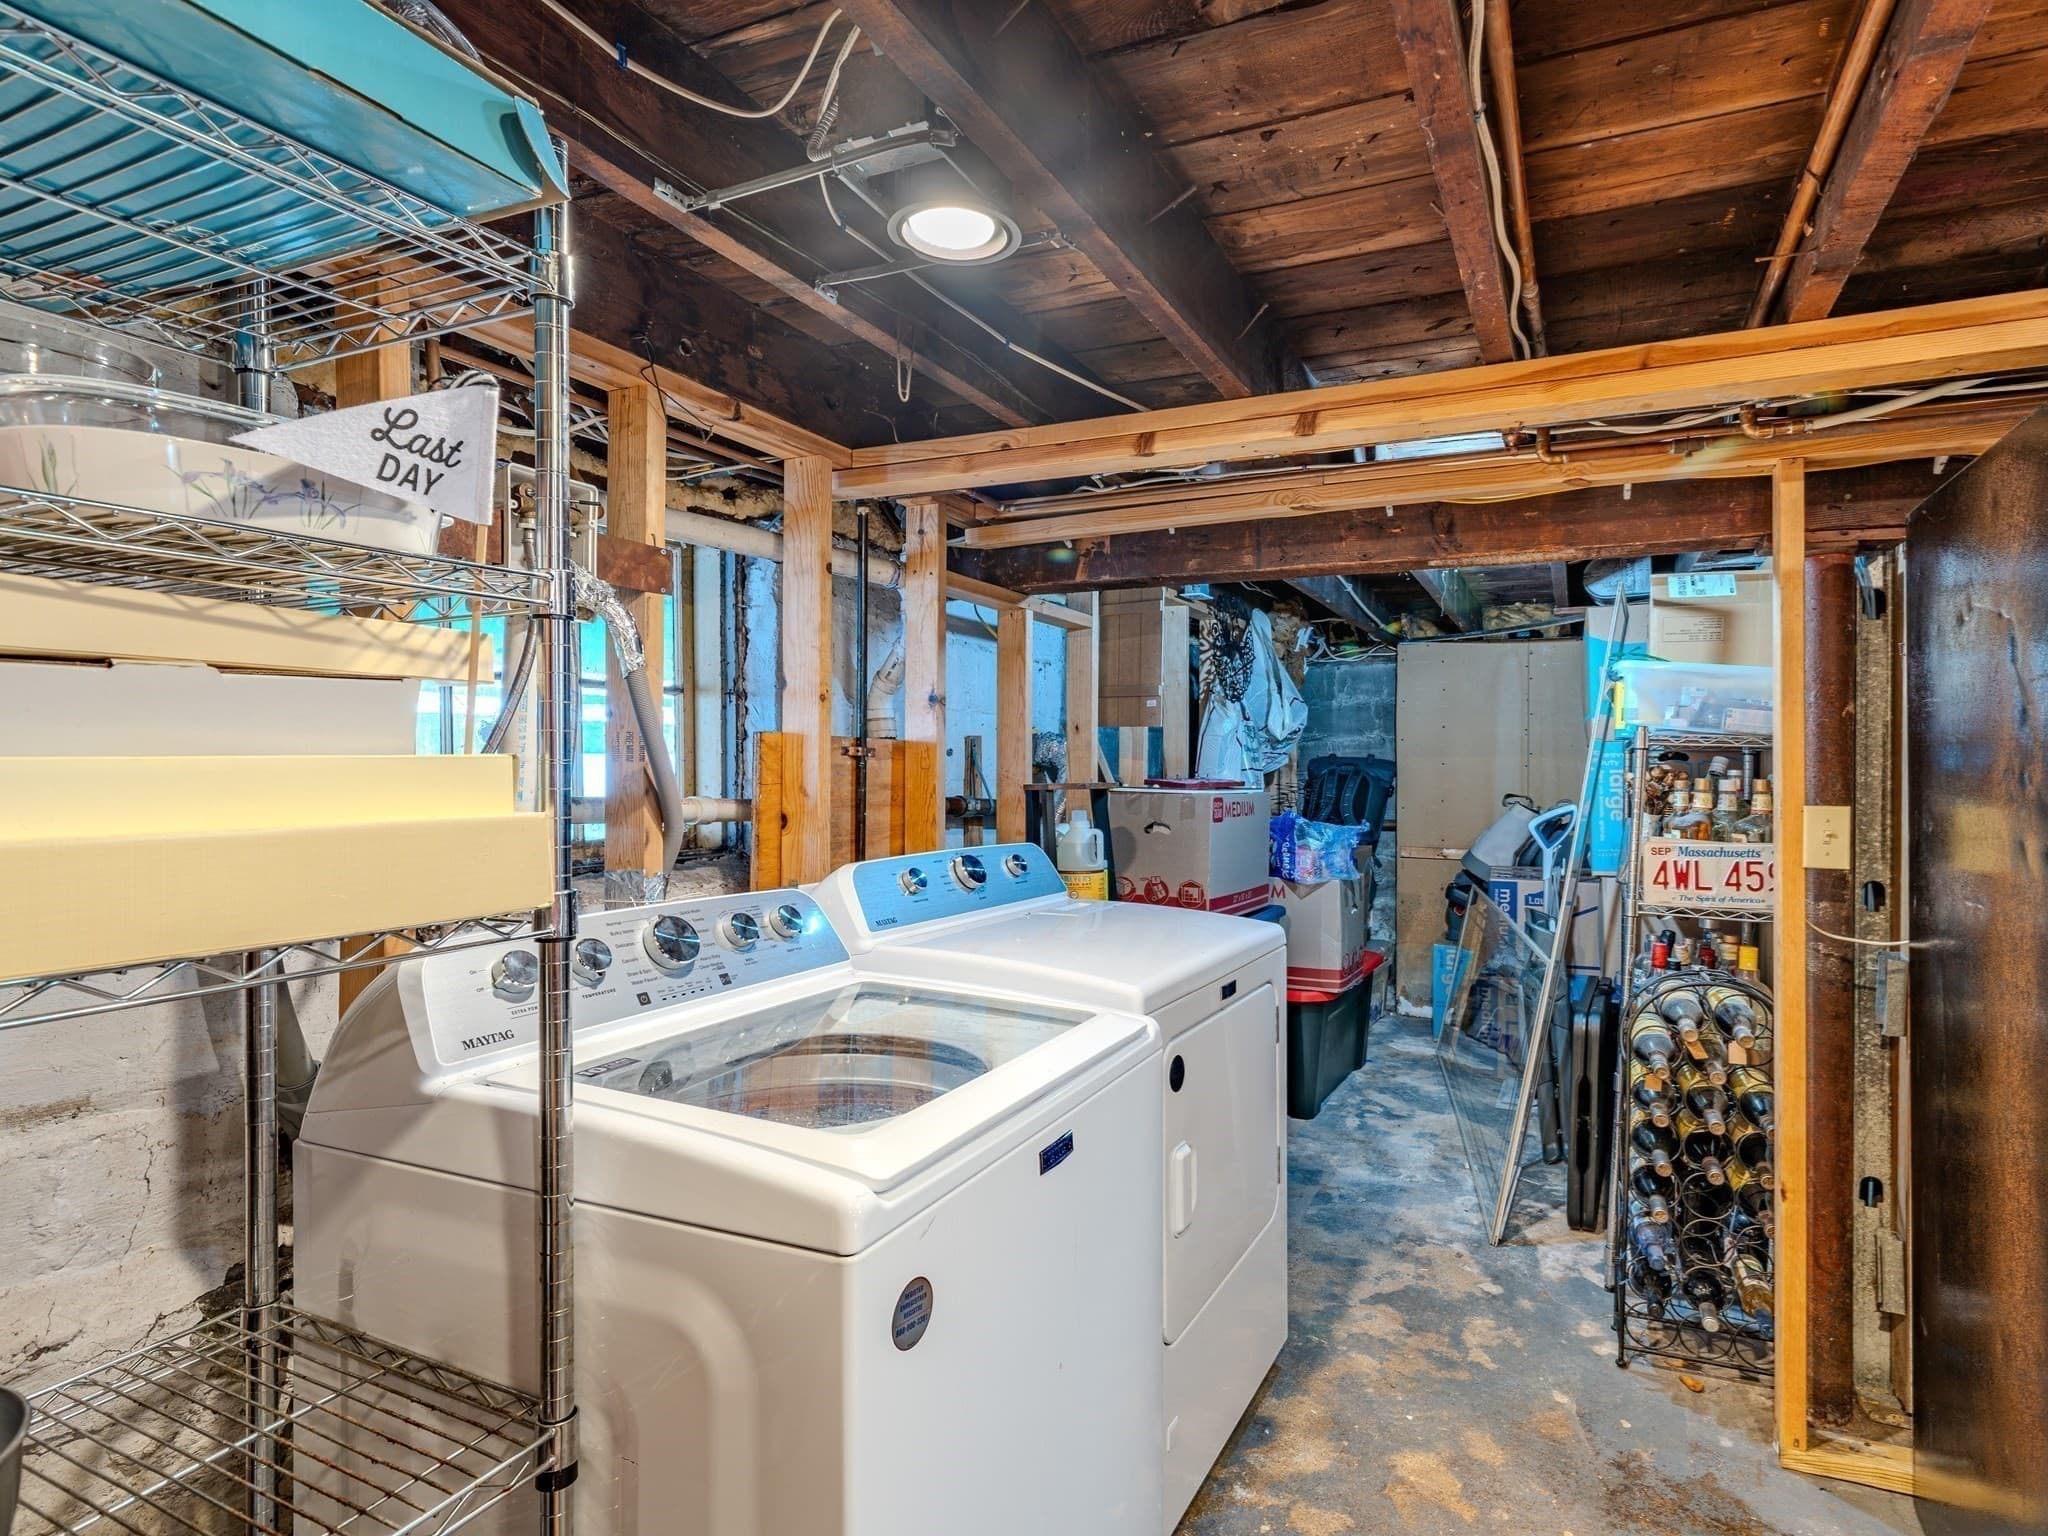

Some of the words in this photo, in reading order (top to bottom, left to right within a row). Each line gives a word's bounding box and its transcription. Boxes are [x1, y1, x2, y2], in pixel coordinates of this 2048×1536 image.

[371, 406, 464, 468] Last
[376, 452, 445, 496] DAY
[1605, 767, 1625, 822] large
[1224, 800, 1256, 818] MEDIUM
[1650, 846, 1672, 856] SEP
[1677, 846, 1761, 858] Massachusetts
[1652, 859, 1713, 891] 4WL
[1680, 894, 1694, 902] The
[1695, 895, 1717, 903] Spirit
[1727, 896, 1761, 904] America
[581, 987, 617, 1000] TEMPERATURE
[461, 1029, 515, 1051] MAYTAG
